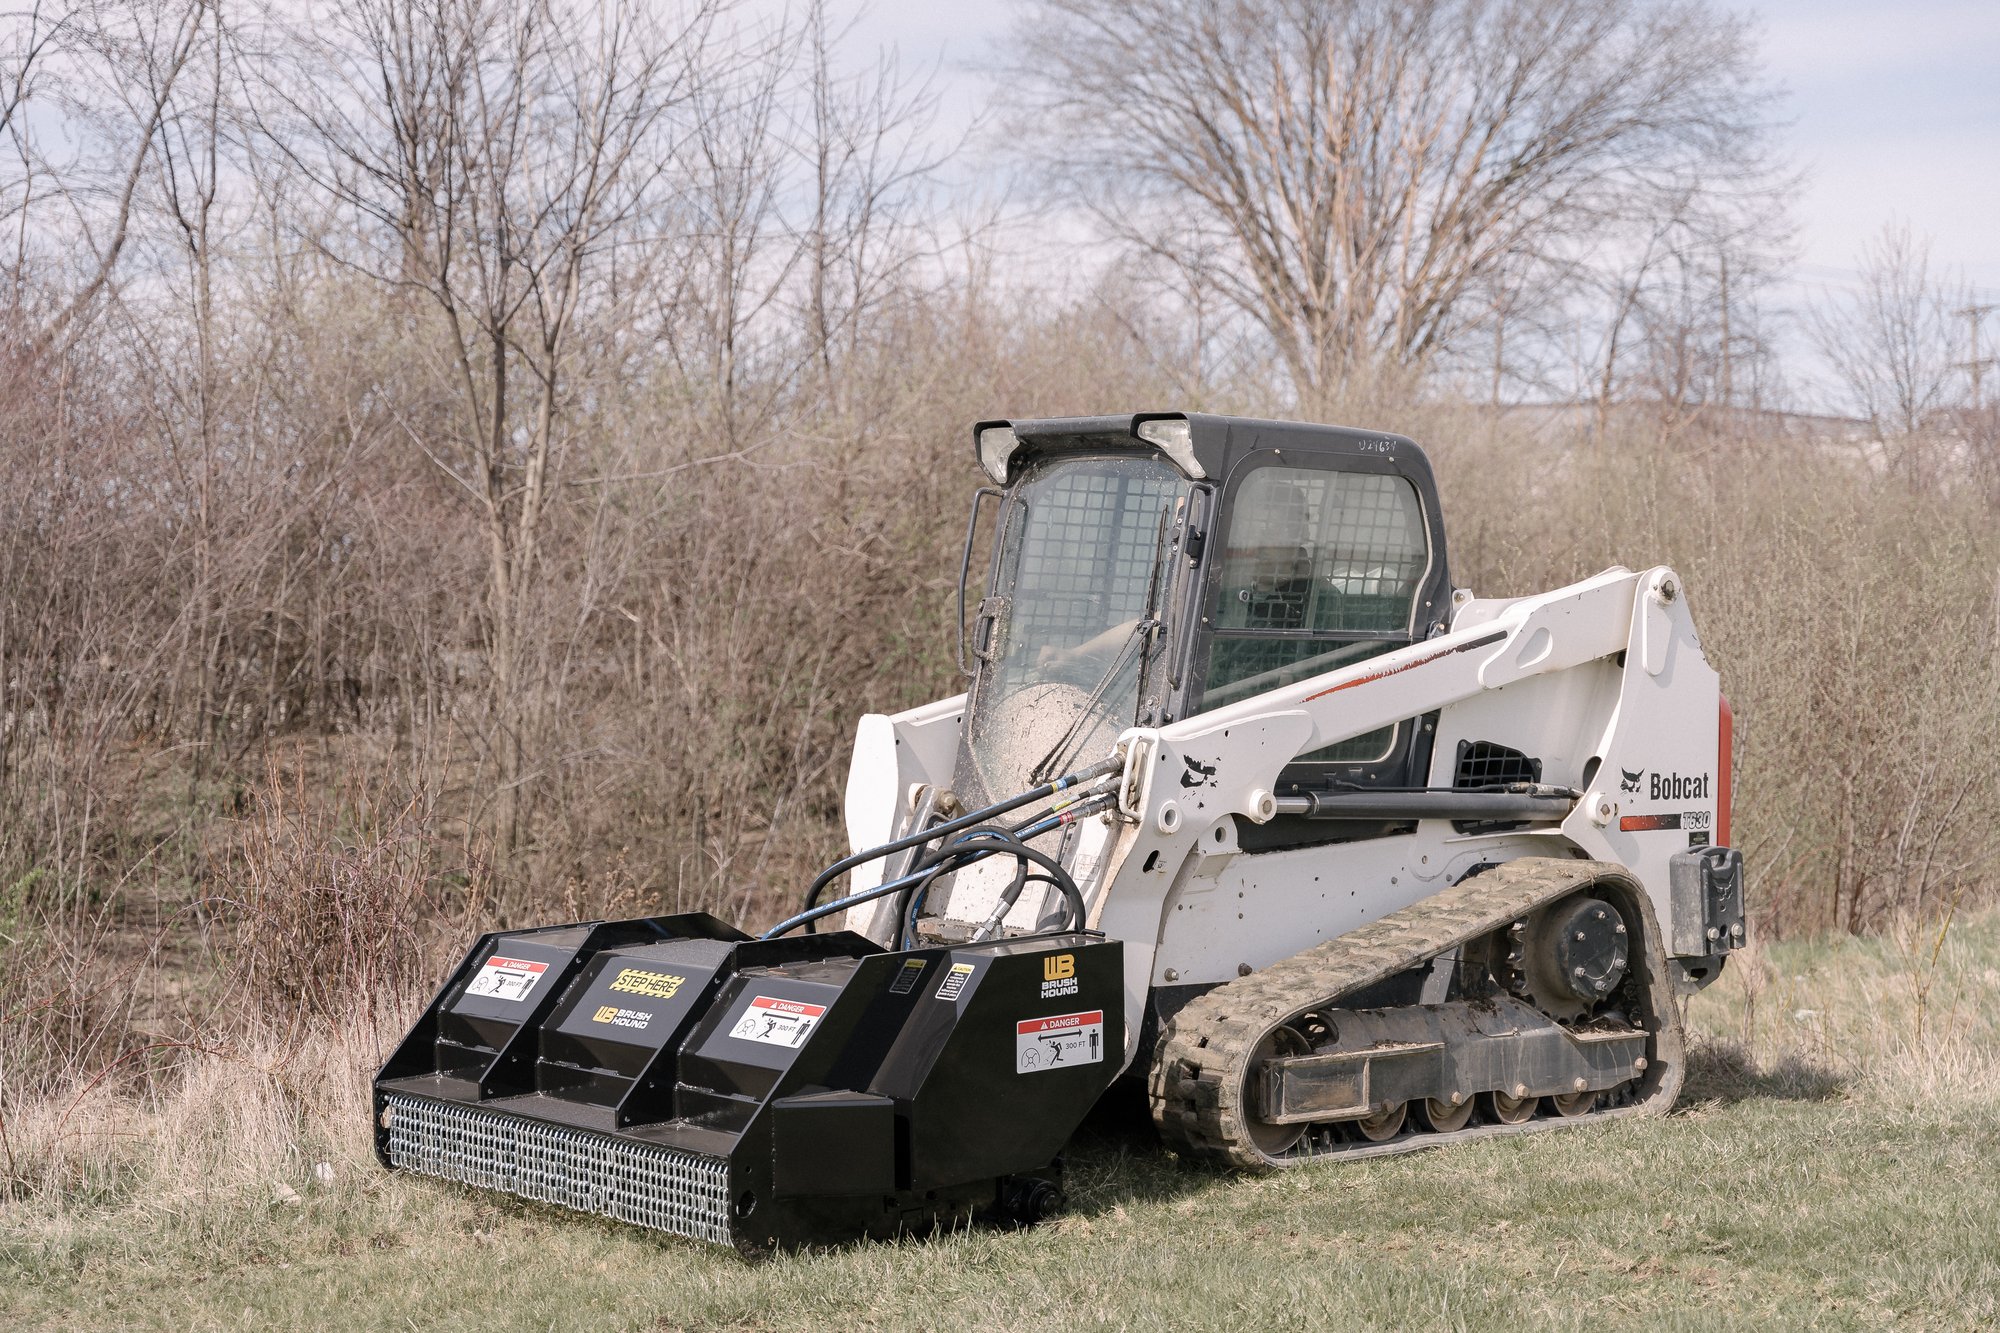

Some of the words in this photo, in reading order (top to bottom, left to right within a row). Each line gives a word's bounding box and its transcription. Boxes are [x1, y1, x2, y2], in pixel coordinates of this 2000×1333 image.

[1650, 772, 1709, 800] Bobcat
[1682, 810, 1711, 830] T630
[507, 961, 532, 970] DANGER
[619, 974, 647, 989] STEP
[645, 978, 677, 993] HERE
[1041, 977, 1078, 990] BRUSH
[1041, 985, 1079, 999] HOUND
[777, 1002, 806, 1013] DANGER
[616, 1008, 653, 1021] BRUSH
[610, 1016, 648, 1030] HOUND
[776, 1024, 788, 1032] 300
[1049, 1017, 1080, 1029] DANGER
[1065, 1041, 1078, 1050] 300
[1078, 1040, 1086, 1048] FT
